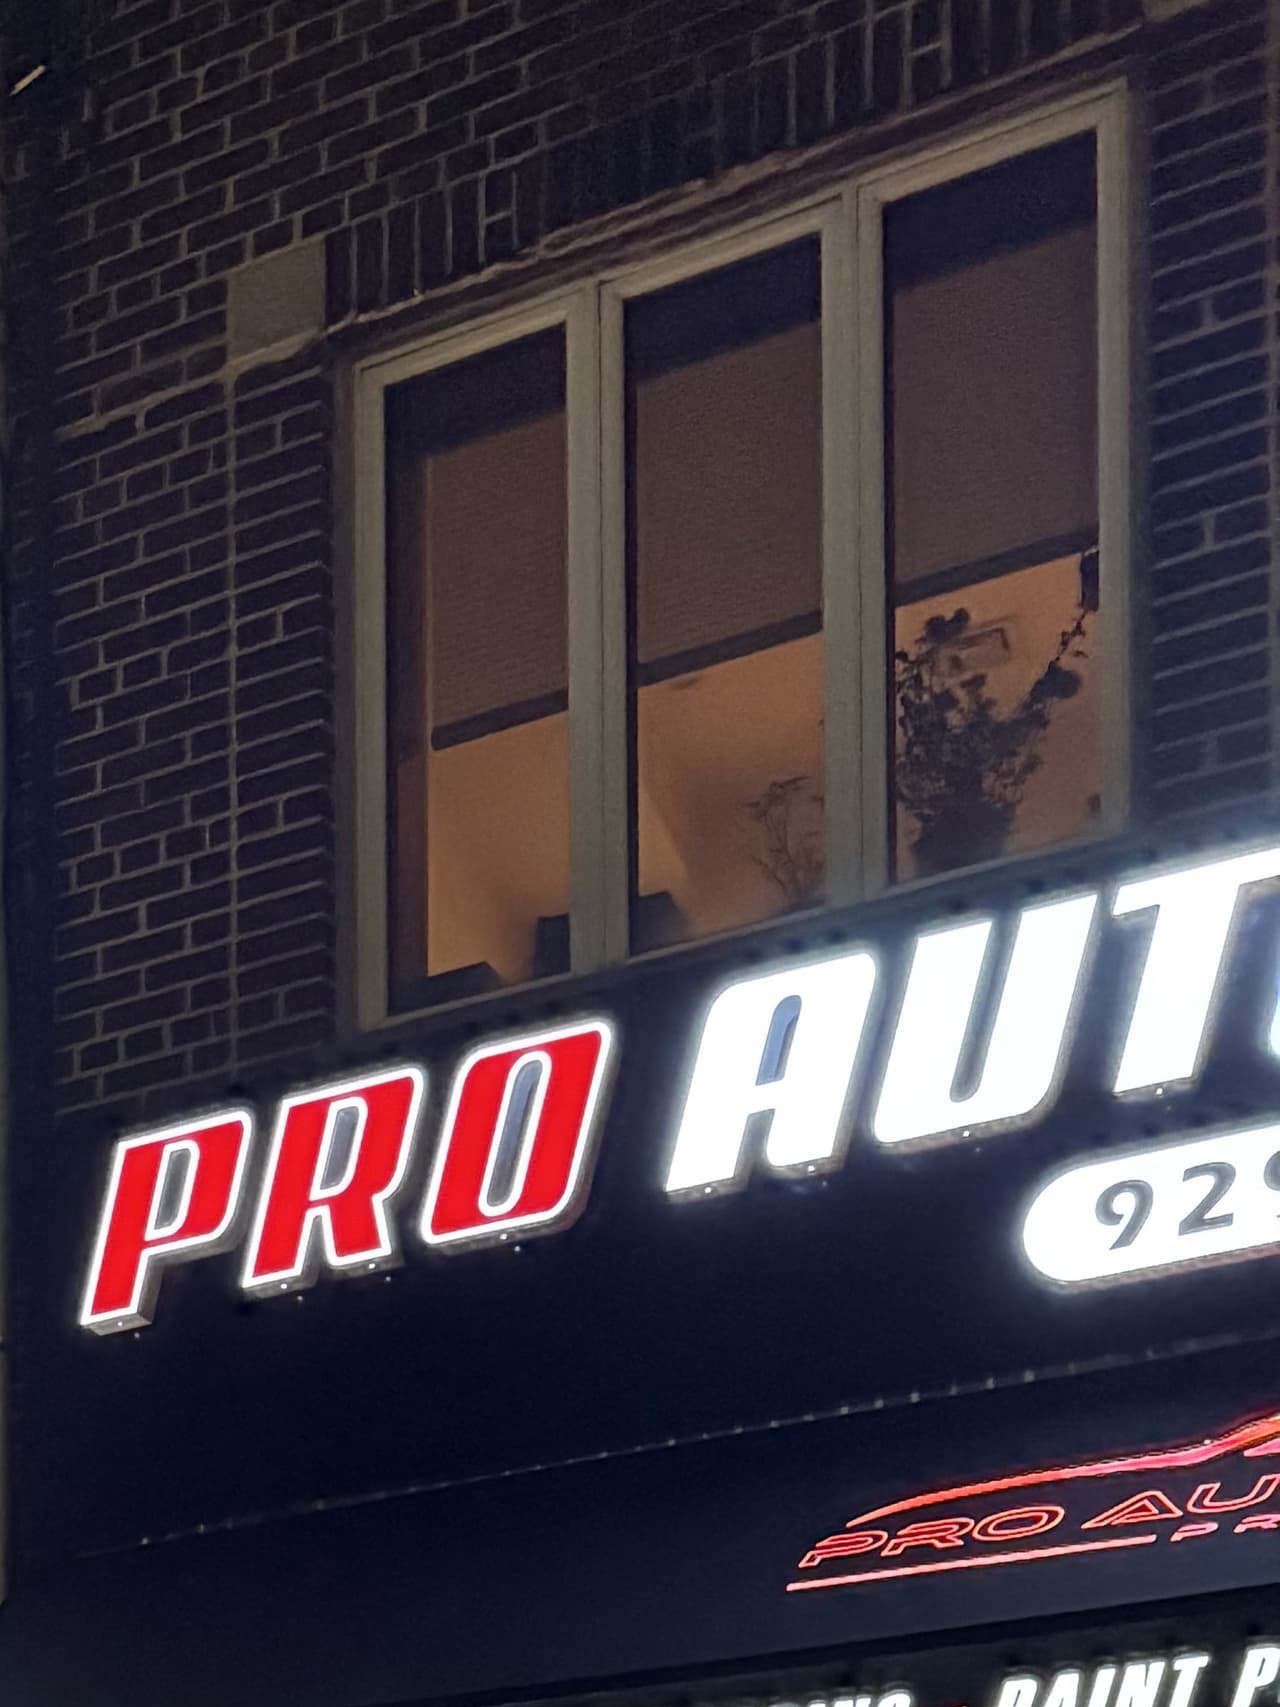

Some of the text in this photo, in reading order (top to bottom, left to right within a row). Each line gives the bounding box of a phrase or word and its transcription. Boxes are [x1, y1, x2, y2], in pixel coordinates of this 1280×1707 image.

[79, 846, 1280, 1328] PRO AUT
[1095, 1150, 1280, 1250] 92
[798, 1506, 1065, 1568] PRO
